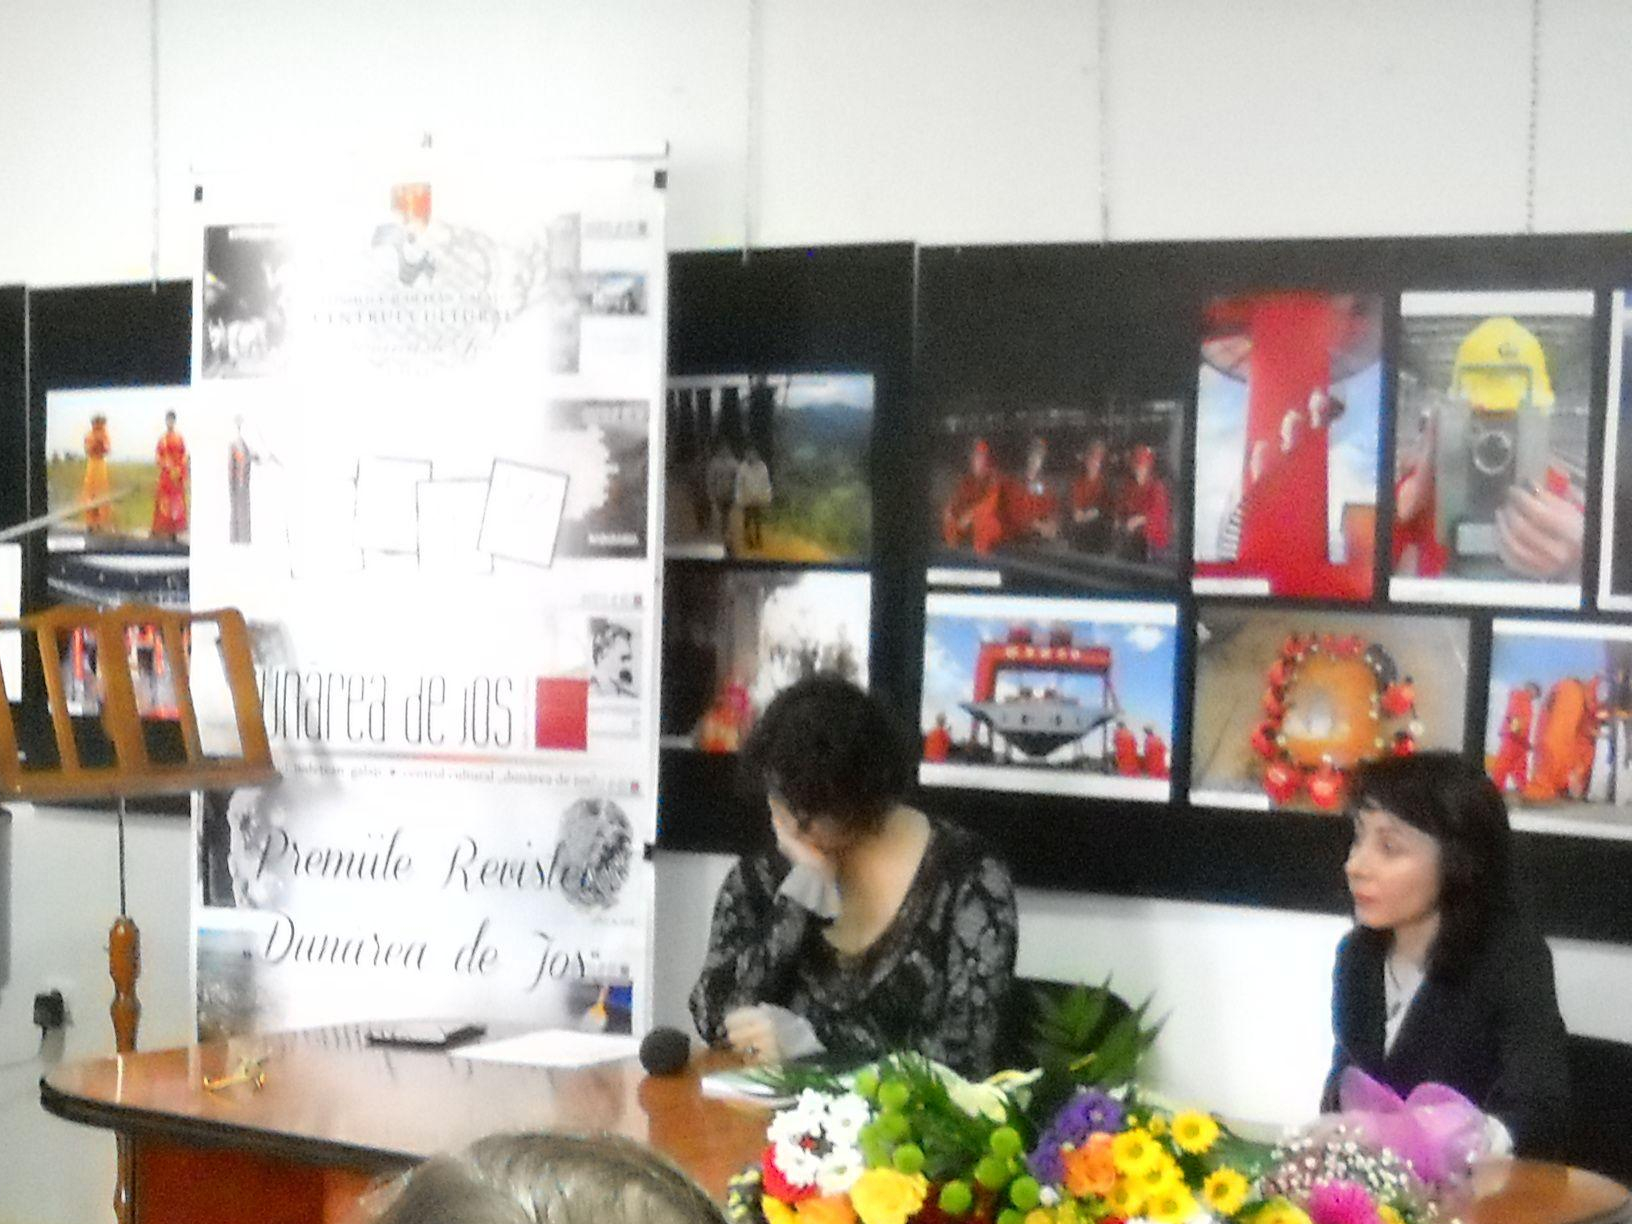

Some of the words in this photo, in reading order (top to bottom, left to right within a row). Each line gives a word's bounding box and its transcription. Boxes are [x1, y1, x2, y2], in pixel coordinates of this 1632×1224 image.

[404, 673, 446, 745] de
[254, 825, 413, 881] Premiile
[454, 916, 499, 976] de
